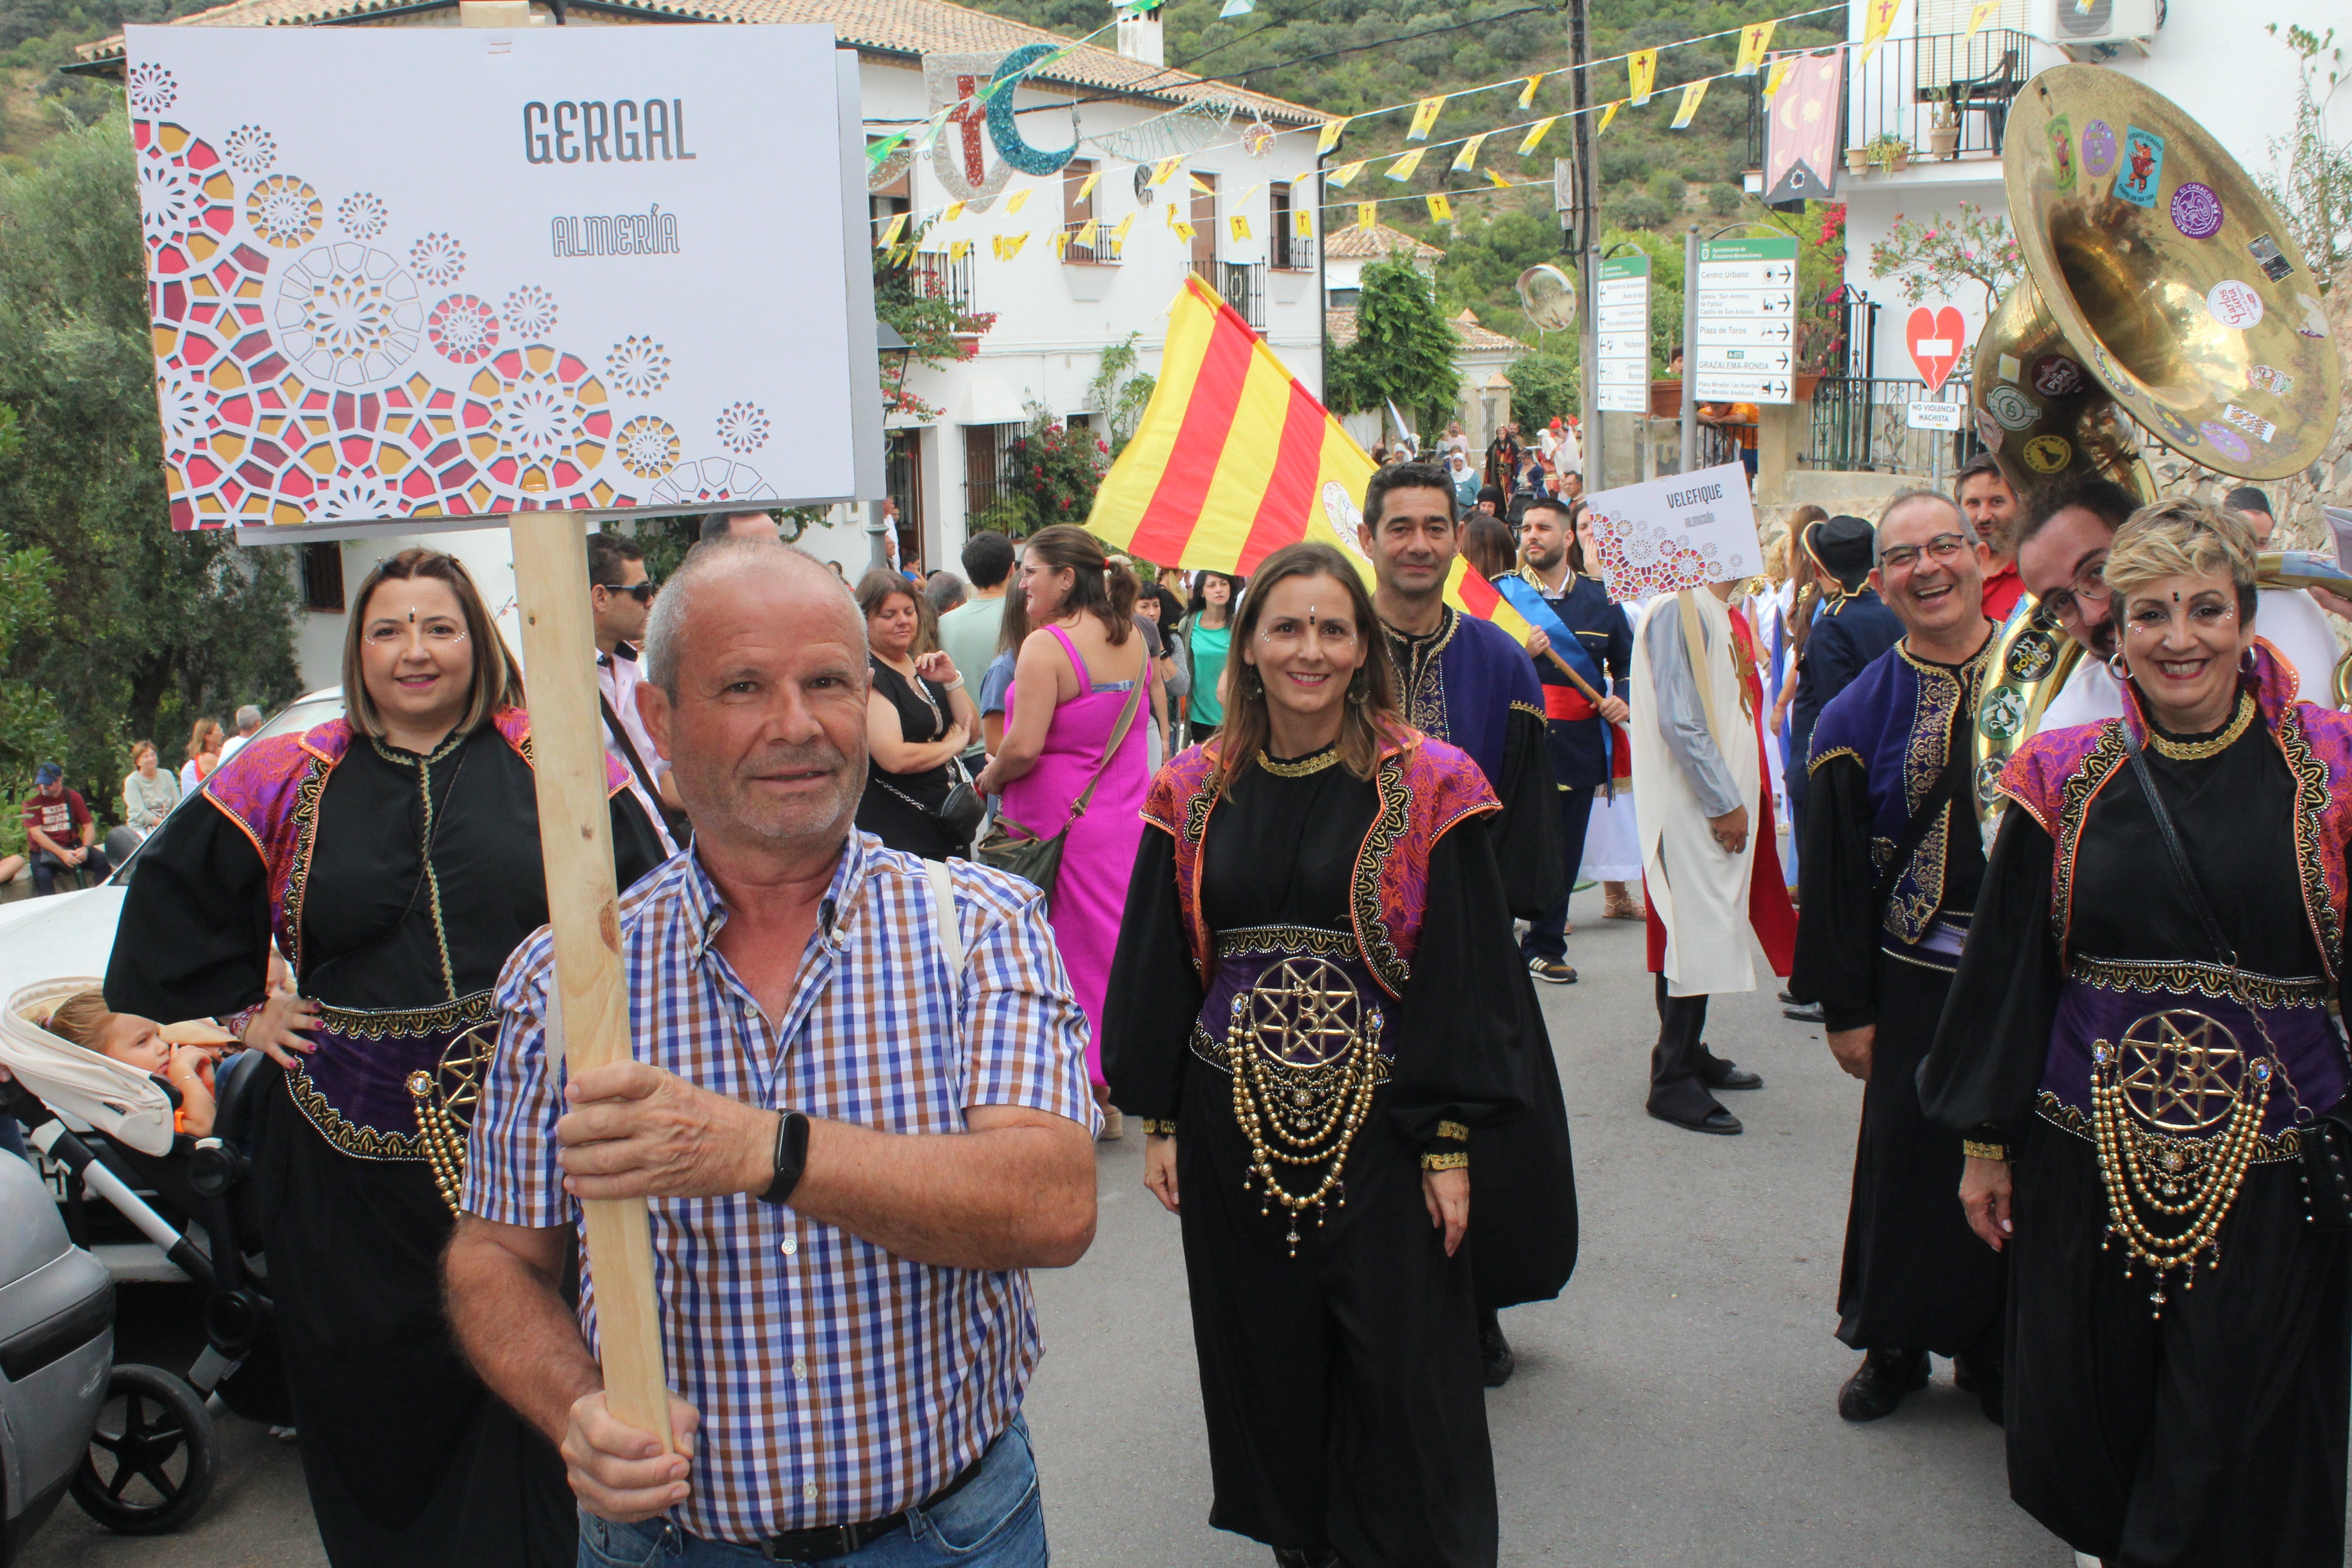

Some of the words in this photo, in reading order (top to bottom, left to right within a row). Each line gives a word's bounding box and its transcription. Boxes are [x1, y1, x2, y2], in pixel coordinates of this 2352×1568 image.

[524, 98, 696, 164] GERGAL
[2188, 184, 2214, 201] CARACOL
[551, 203, 680, 258] ALMERÍA
[2219, 289, 2240, 324] Carlos
[2228, 288, 2246, 318] Luna
[1699, 361, 1769, 370] GRAZALEMA-RONDA
[2046, 369, 2071, 390] PEPA
[1924, 405, 1956, 413] VIOLENCIA
[1666, 483, 1723, 509] VELEFIQUE
[2013, 642, 2049, 673] SOUND
[2021, 652, 2051, 678] BAND
